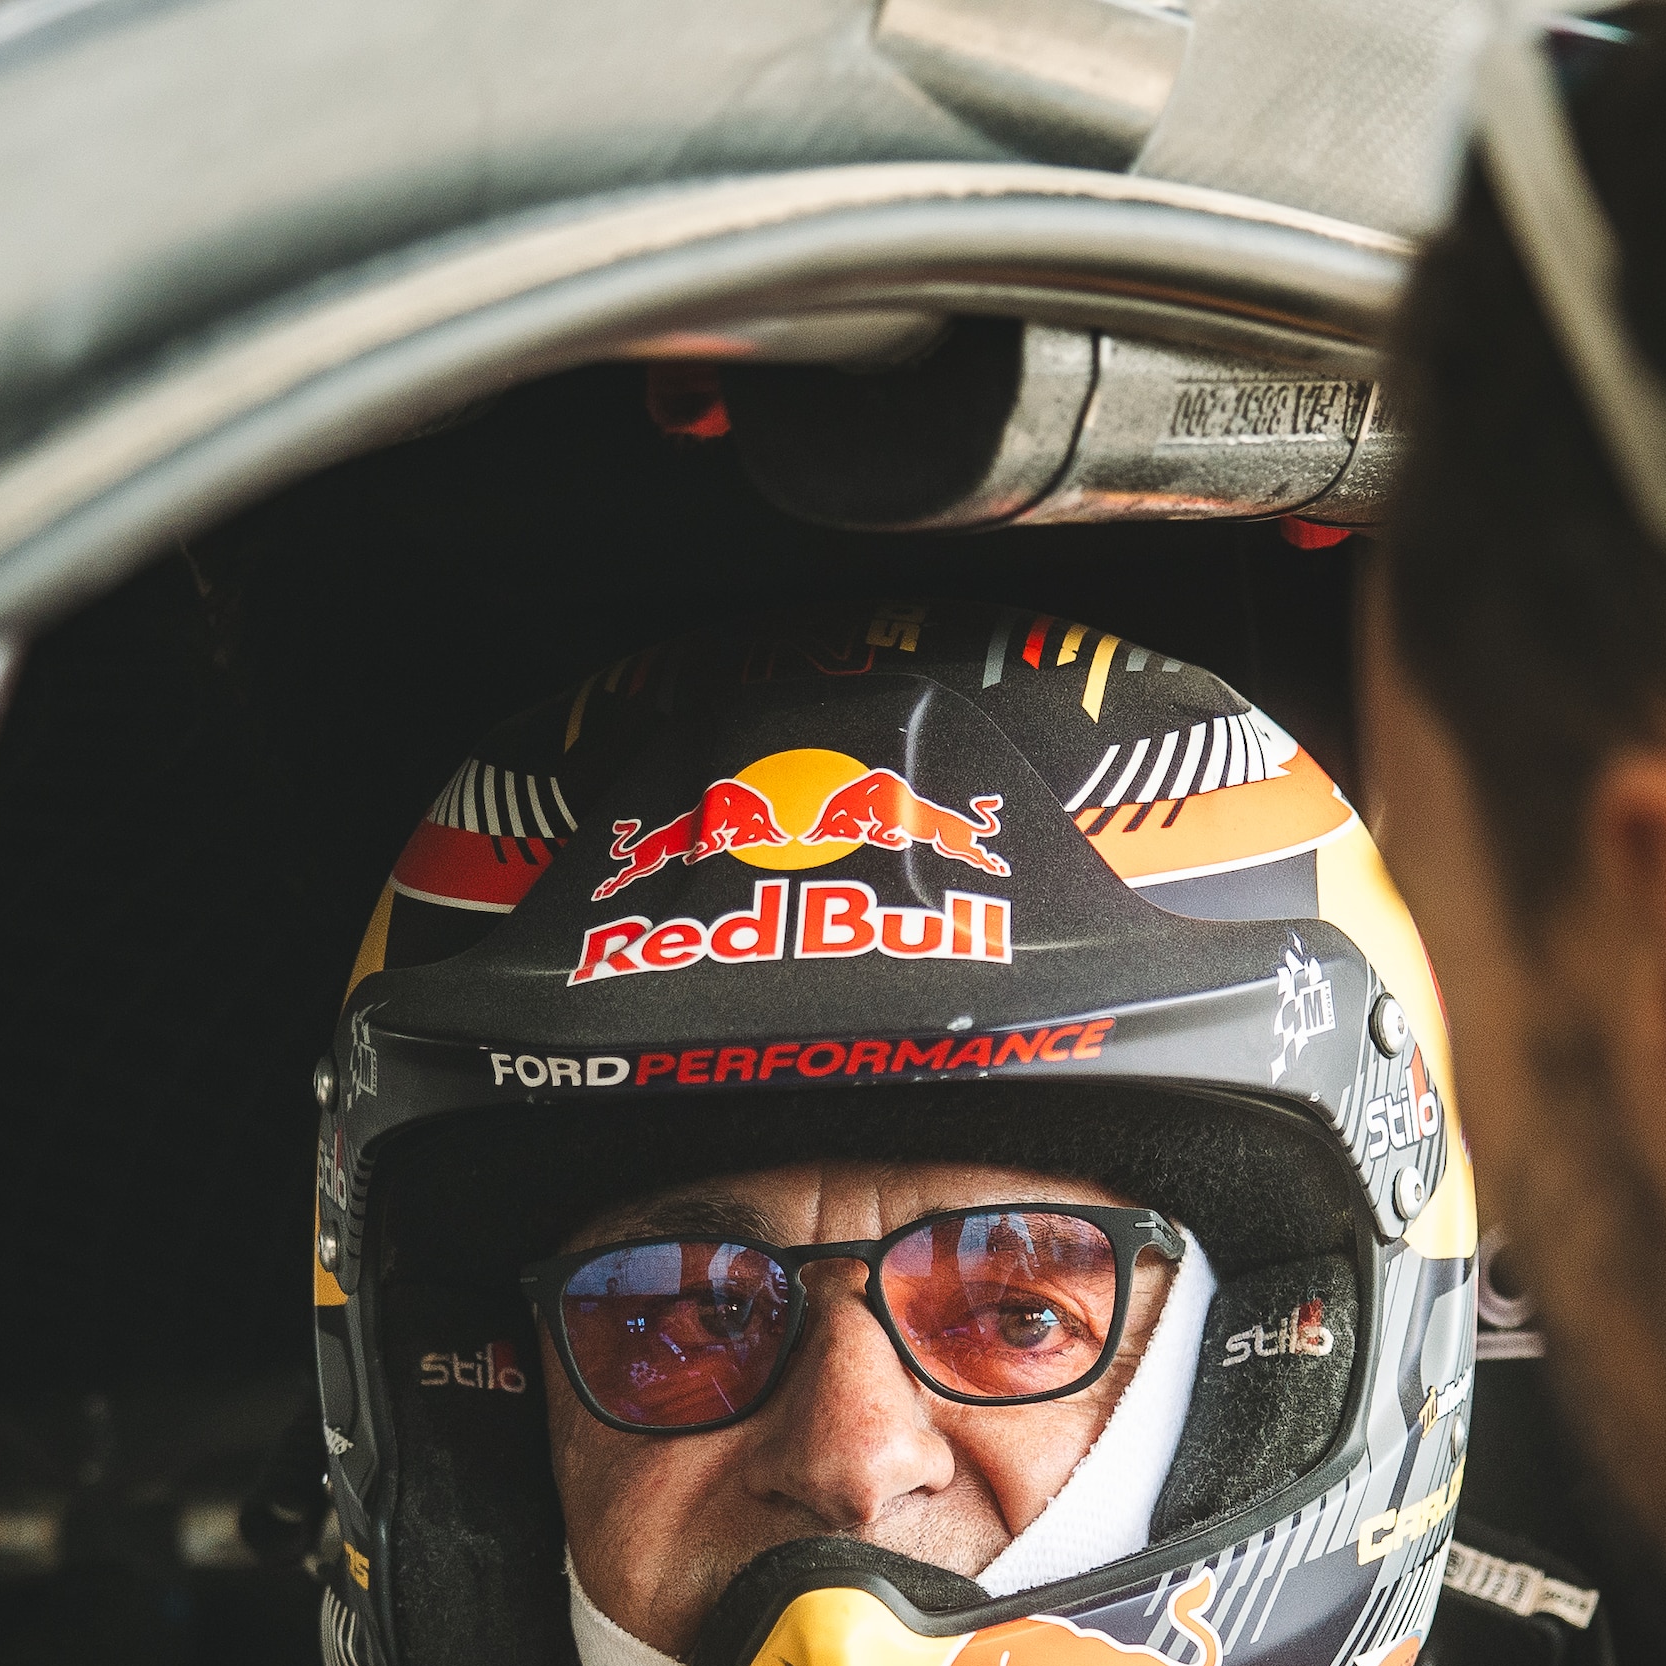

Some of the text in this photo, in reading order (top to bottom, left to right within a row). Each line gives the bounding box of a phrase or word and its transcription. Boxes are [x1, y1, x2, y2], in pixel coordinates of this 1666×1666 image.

[567, 879, 1012, 987] Red Bull
[490, 1018, 1116, 1087] FORD PERFORMANCE
[1366, 1062, 1439, 1162] stilo
[420, 1343, 526, 1394] stilo
[1222, 1304, 1334, 1367] stilo
